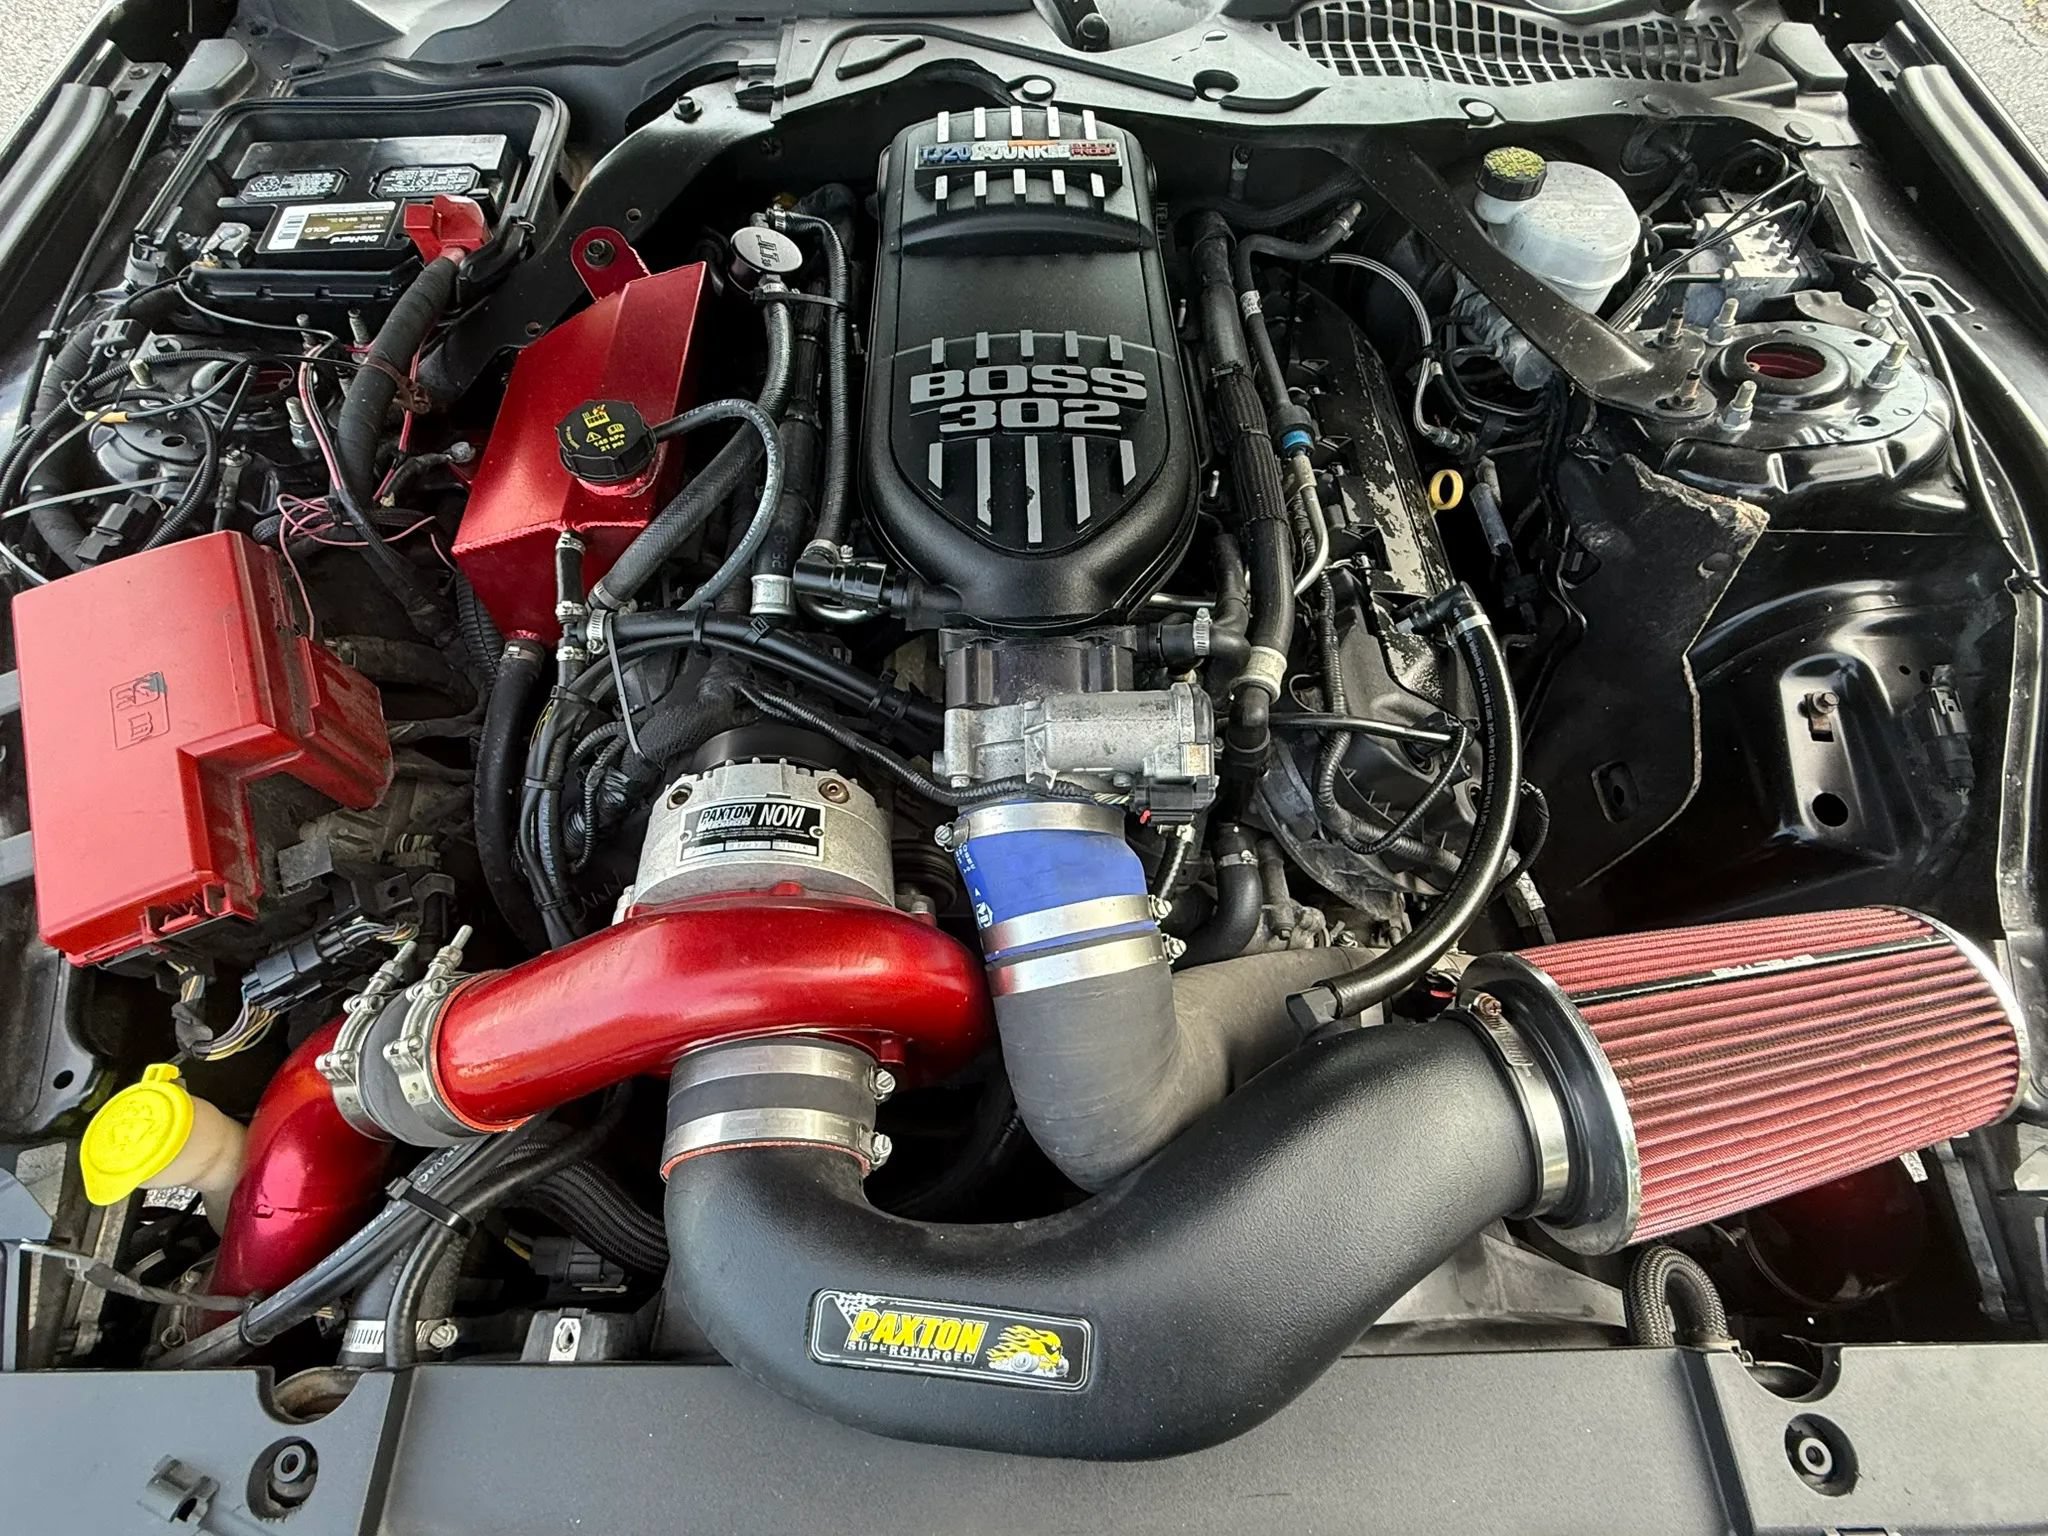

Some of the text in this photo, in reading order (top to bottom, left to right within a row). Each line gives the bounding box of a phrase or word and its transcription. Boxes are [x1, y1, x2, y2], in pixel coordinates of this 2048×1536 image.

[329, 234, 379, 245] DieHard
[909, 365, 1148, 404] BOSS
[938, 398, 1122, 433] 302
[701, 805, 807, 829] PAXTON NOVI
[850, 1310, 986, 1355] PAXTON
[846, 1340, 976, 1364] SUPERCHARGED
